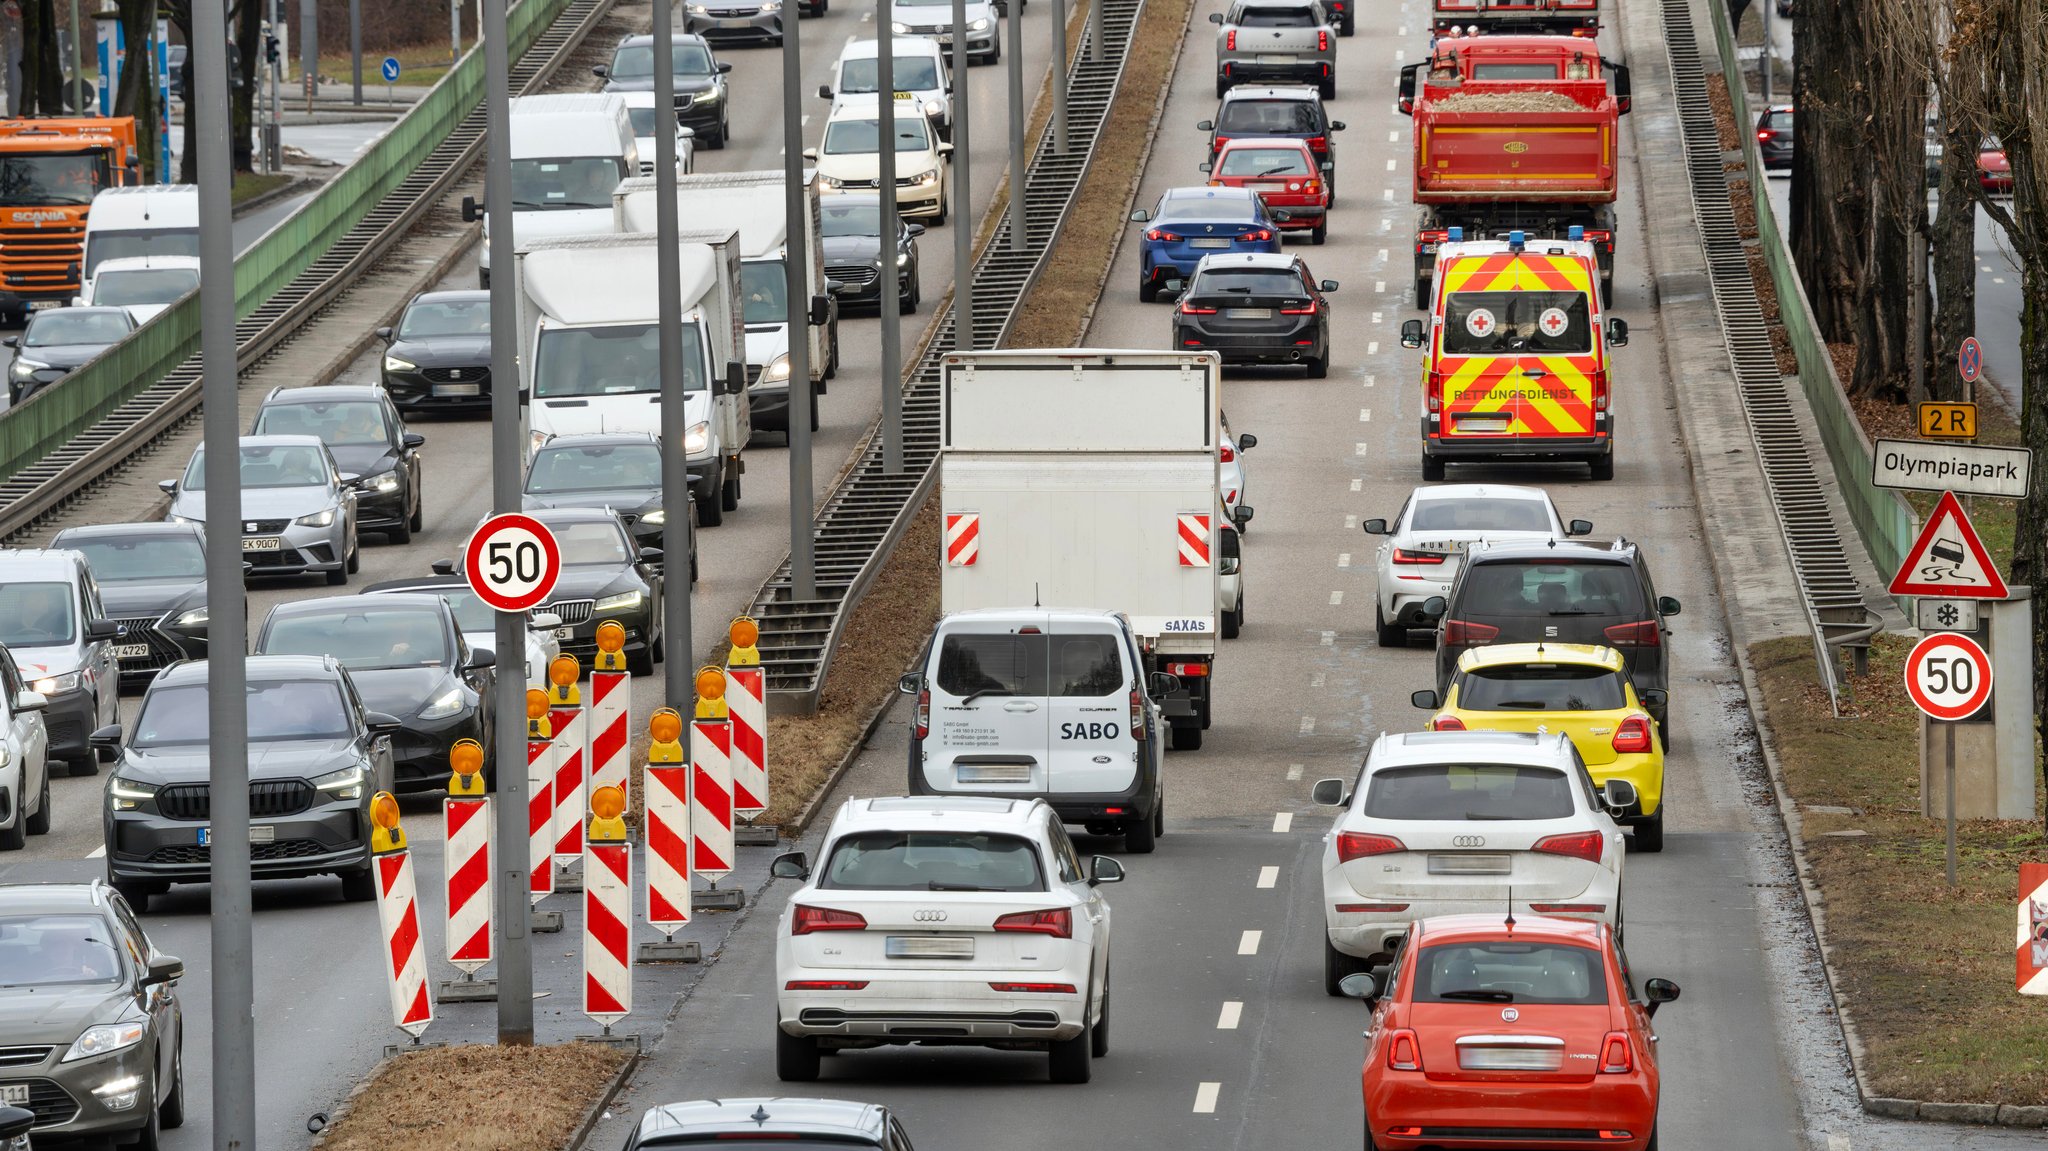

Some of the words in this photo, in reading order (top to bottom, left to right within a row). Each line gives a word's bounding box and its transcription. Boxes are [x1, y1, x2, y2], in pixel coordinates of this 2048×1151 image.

[13, 212, 67, 223] SCANIA
[1454, 389, 1577, 401] RETTUNGSDIENST
[1930, 409, 1943, 432] 2
[1950, 409, 1967, 432] R
[1884, 453, 2018, 481] Olympiapark
[242, 540, 254, 550] EK
[256, 539, 279, 549] 9007
[489, 541, 540, 584] 50
[1165, 619, 1206, 631] SAXAS
[122, 645, 147, 656] 4729
[1927, 657, 1973, 695] 50
[1061, 722, 1119, 740] SABO
